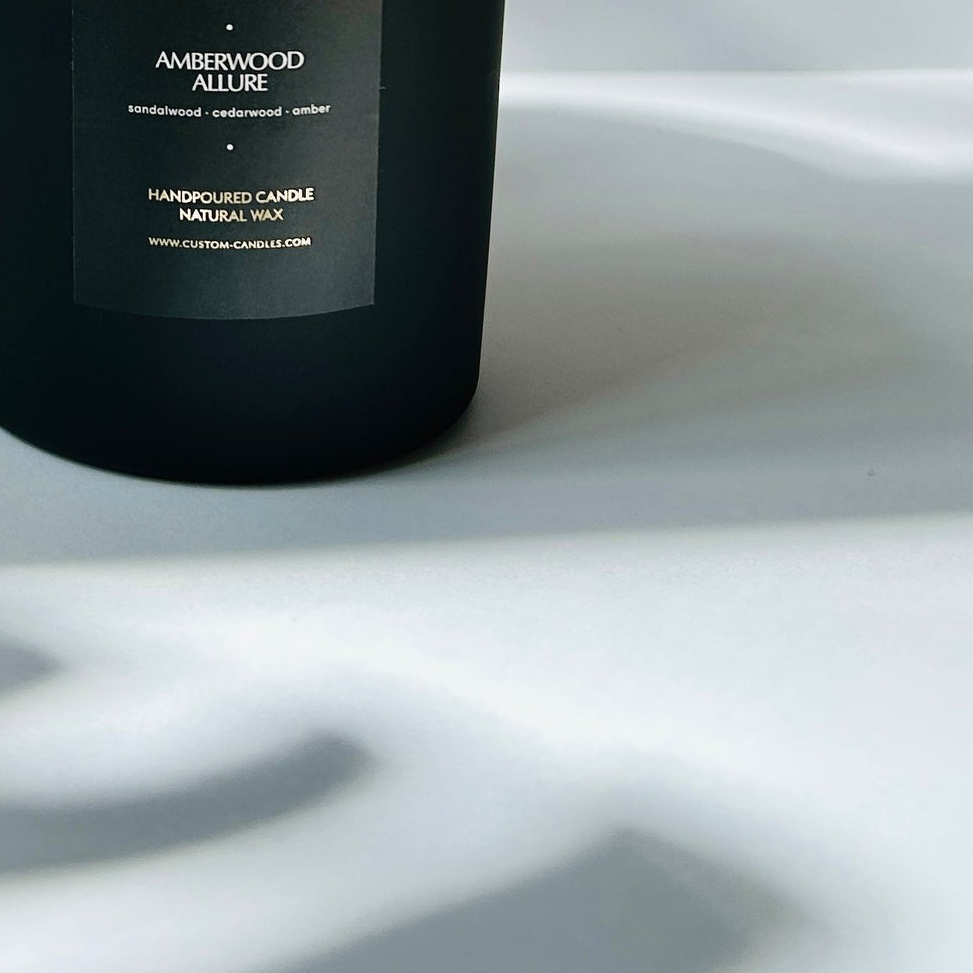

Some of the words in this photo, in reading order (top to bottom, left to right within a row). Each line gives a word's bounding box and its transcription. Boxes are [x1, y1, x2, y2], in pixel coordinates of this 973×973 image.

[155, 50, 305, 71] AMBERWOOD
[191, 74, 269, 92] ALLURE
[128, 103, 202, 117] sandalwood
[211, 106, 282, 118] cedarwood
[291, 103, 331, 116] amber
[148, 188, 253, 205] HANDPOURED
[255, 187, 315, 204] CANDLE
[179, 207, 247, 223] NATURAL
[250, 208, 284, 221] WAX
[148, 236, 312, 250] WWW.CUSTOM-CANDLES.COM
